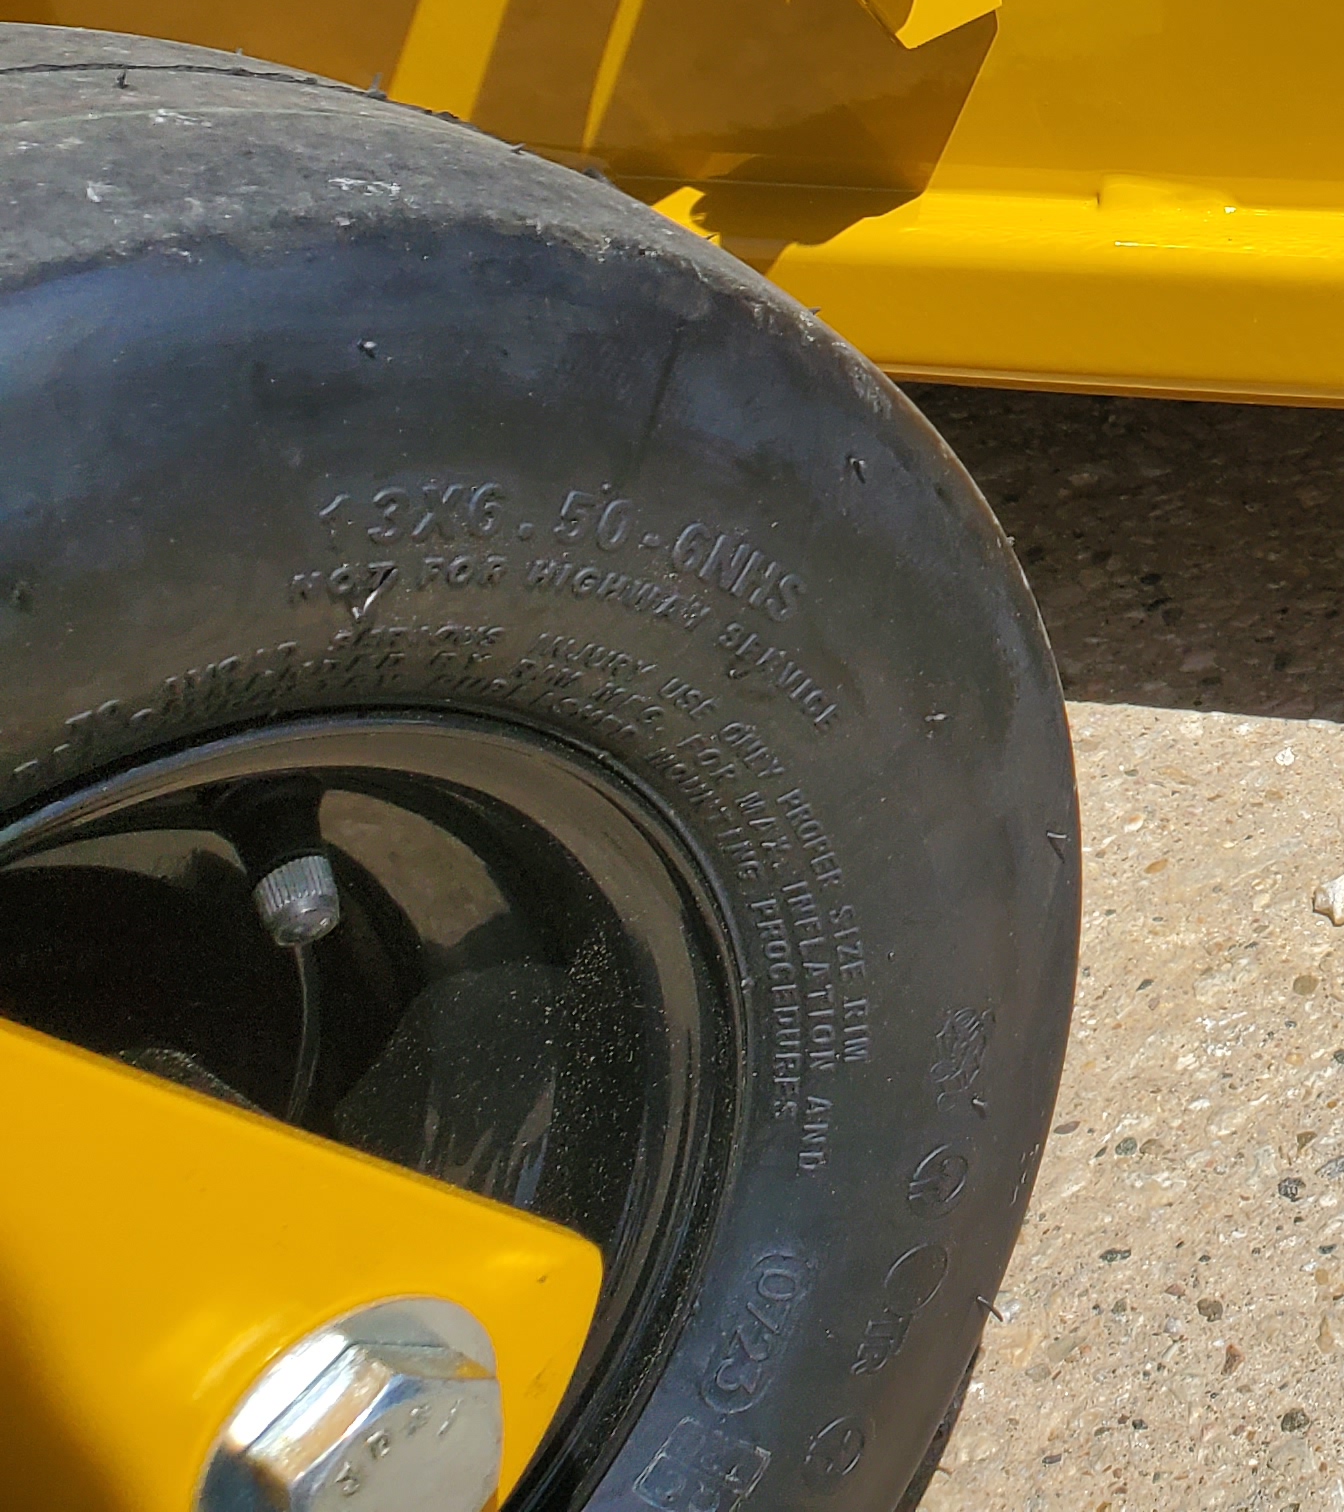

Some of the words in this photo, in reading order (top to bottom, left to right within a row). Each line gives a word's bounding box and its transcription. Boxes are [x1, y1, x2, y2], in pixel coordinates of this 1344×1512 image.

[416, 553, 508, 591] FOR
[524, 558, 712, 631] HIGHWAY
[657, 676, 720, 720] USE
[776, 788, 844, 887] PROPER
[781, 880, 837, 1070] INFLATION
[829, 904, 866, 979] SIZE
[842, 996, 870, 1063] RIM
[799, 1095, 834, 1171] AND
